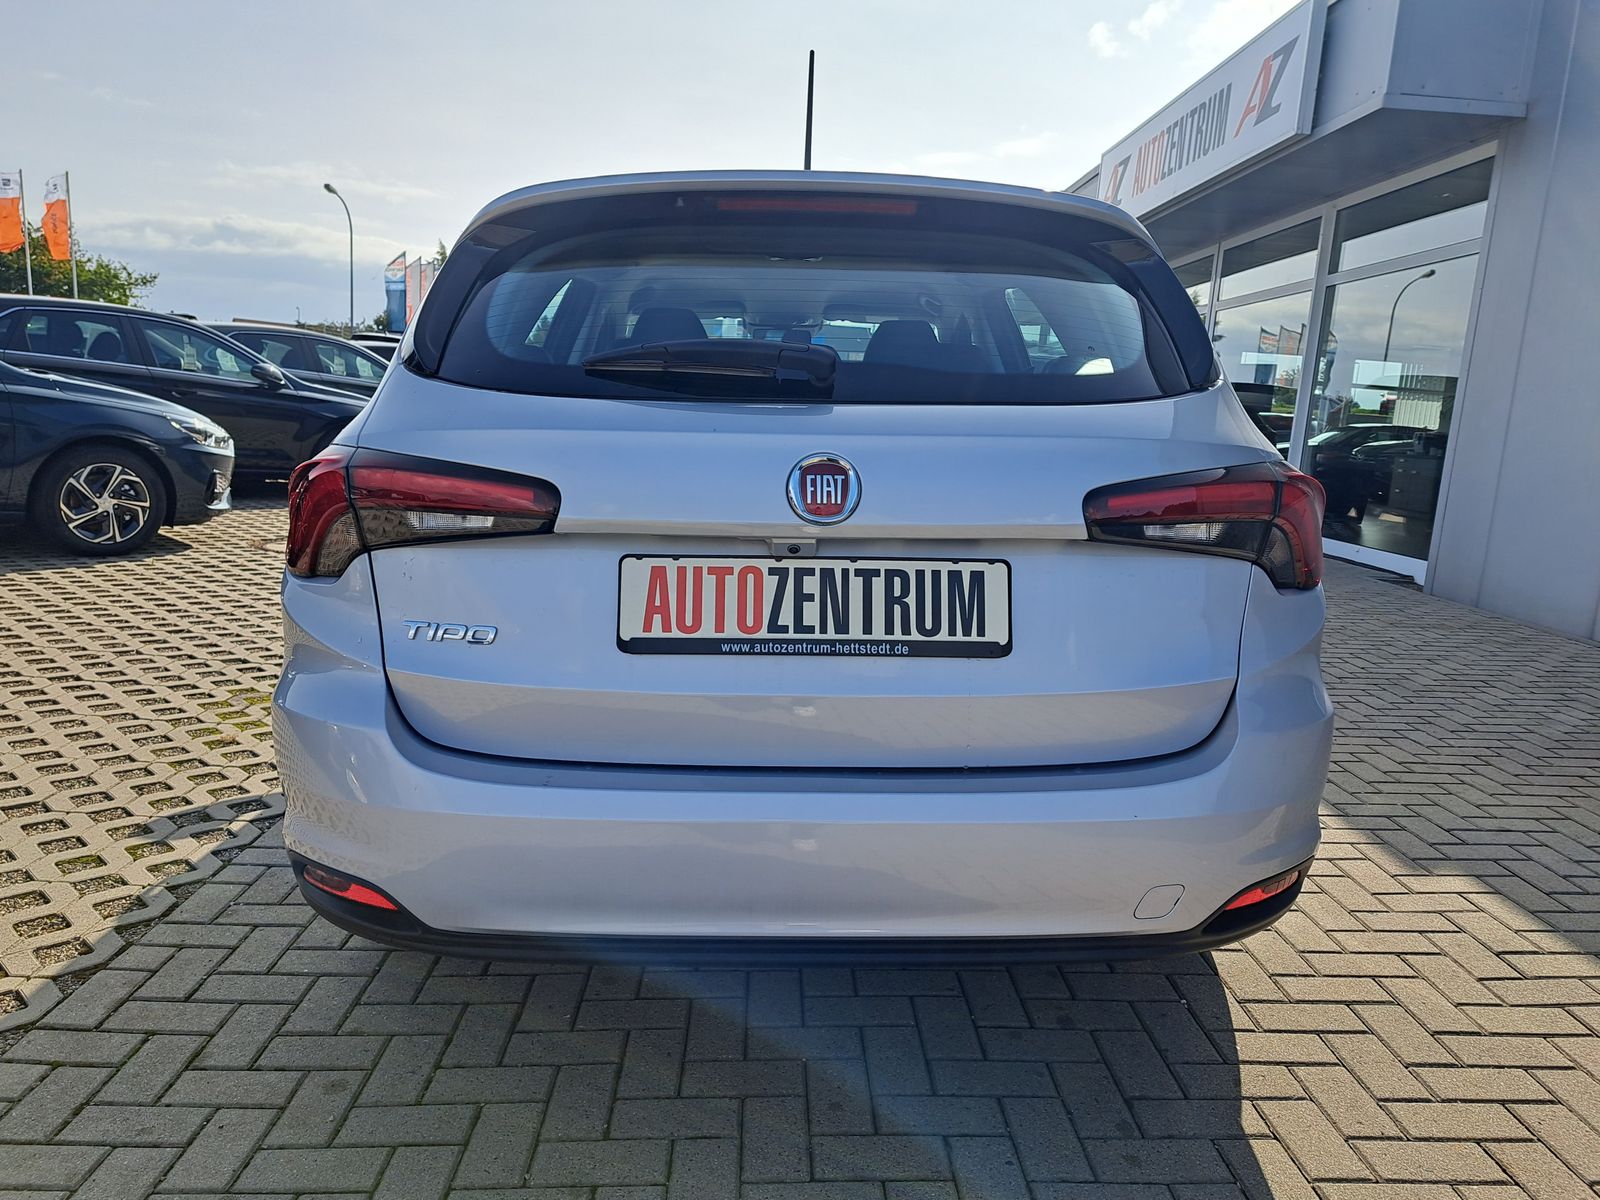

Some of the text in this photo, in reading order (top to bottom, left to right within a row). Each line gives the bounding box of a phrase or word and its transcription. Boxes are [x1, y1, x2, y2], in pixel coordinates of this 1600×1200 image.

[1132, 82, 1233, 198] AUTOZENTRUM
[1233, 34, 1301, 139] AZ
[806, 473, 846, 506] FIAT
[642, 565, 986, 638] AUTOZENTRUM
[402, 619, 498, 645] TIPO
[720, 641, 910, 656] www.autozentrum-hettstedt.de
